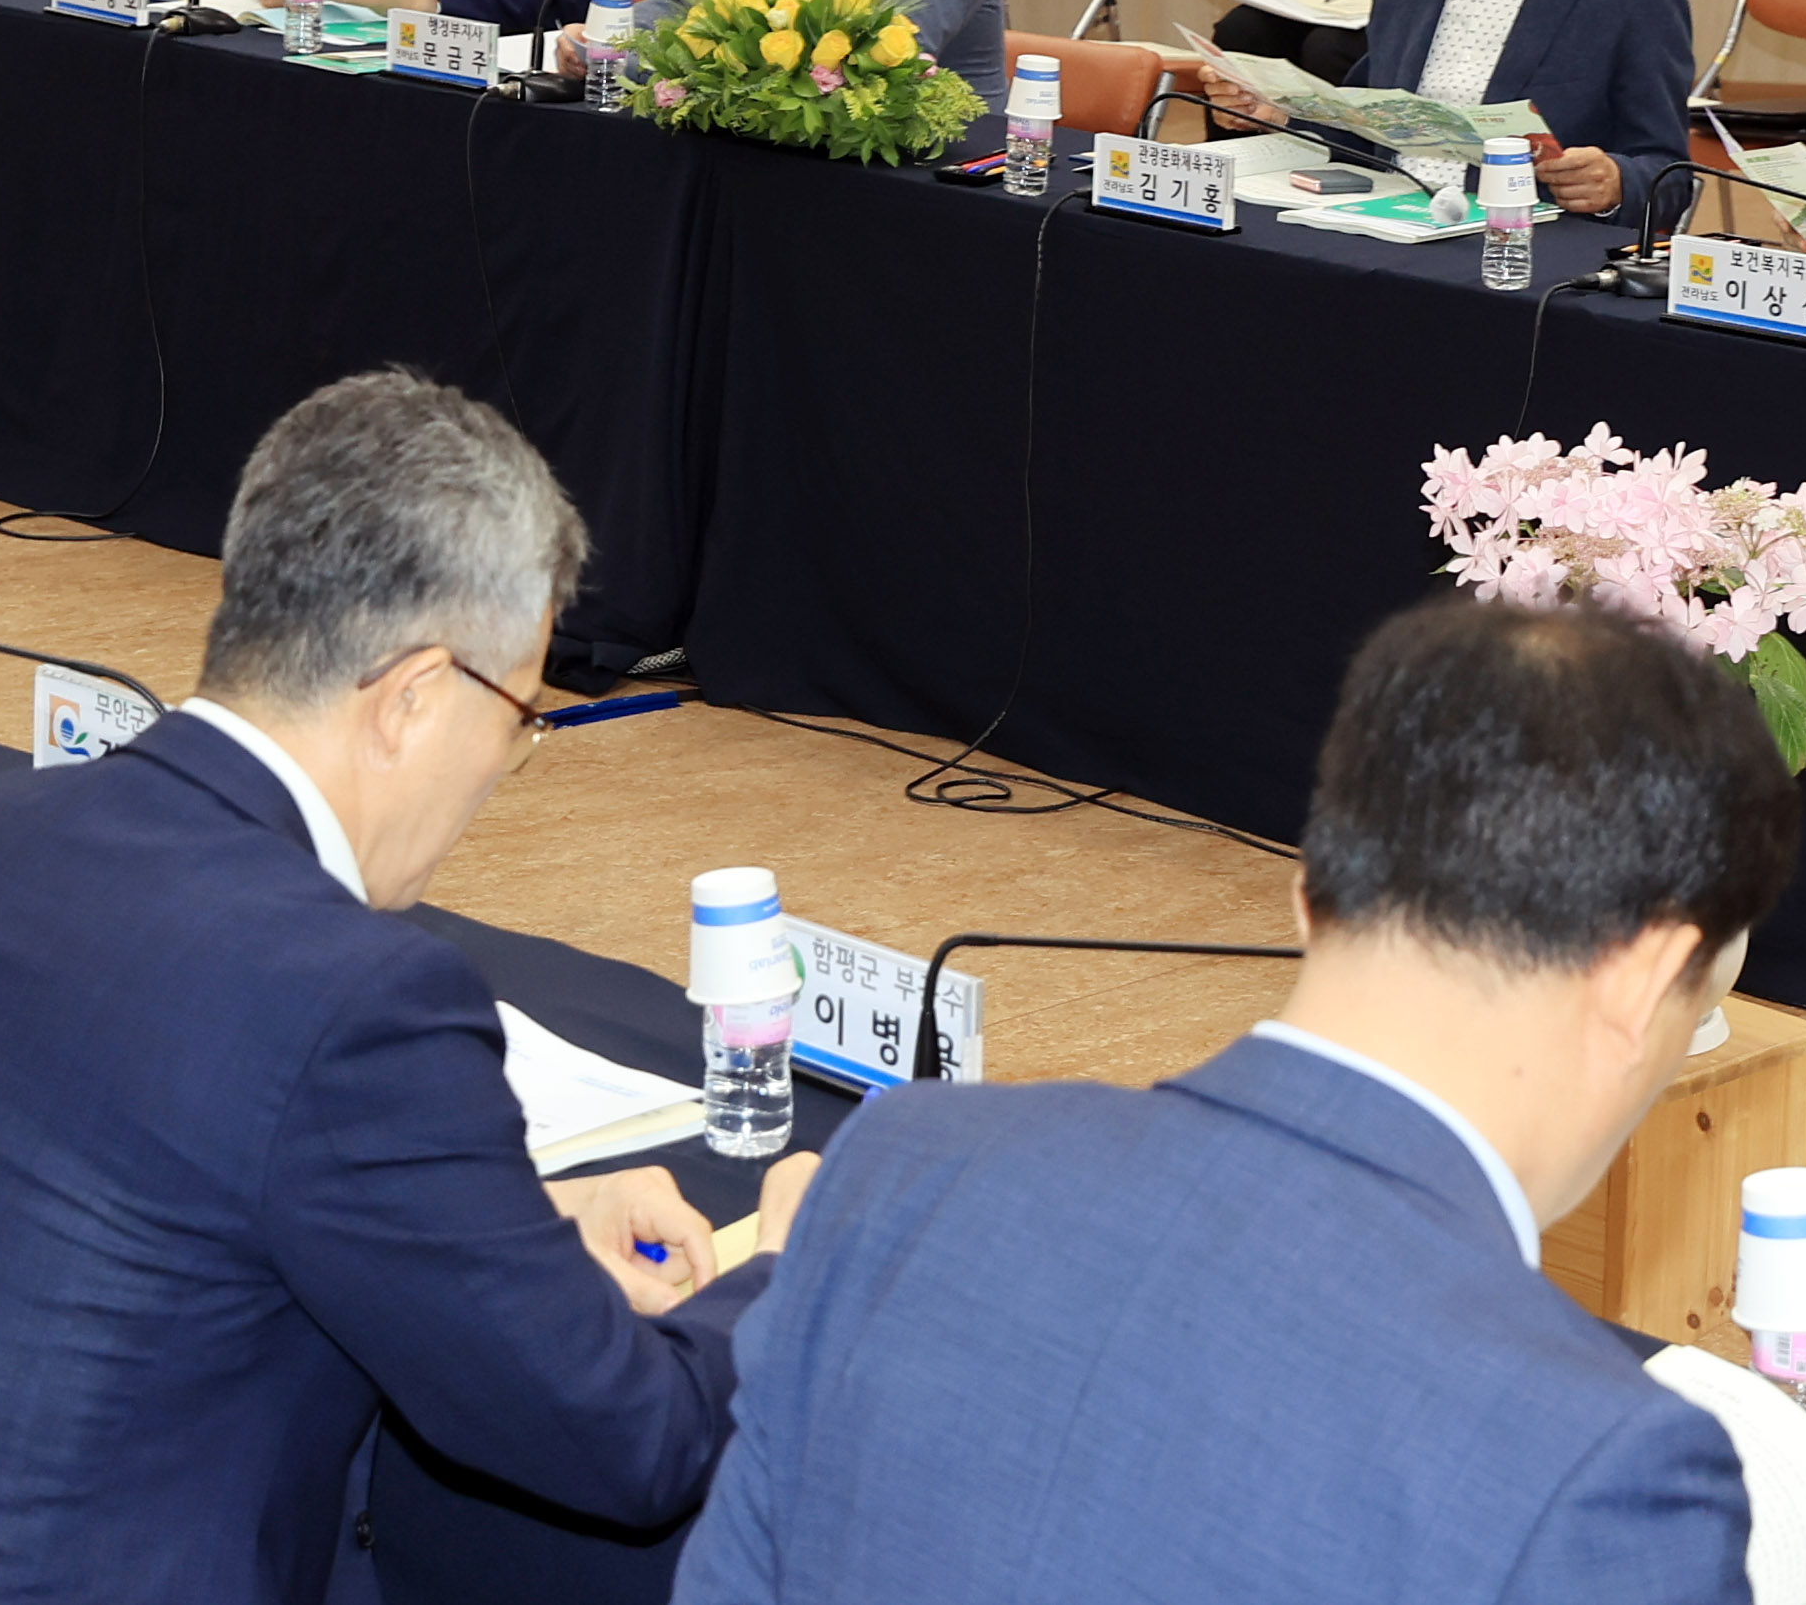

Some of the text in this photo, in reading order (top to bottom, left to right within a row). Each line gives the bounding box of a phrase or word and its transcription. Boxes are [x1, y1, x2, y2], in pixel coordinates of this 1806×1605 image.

[428, 16, 483, 42] 행정부지사
[422, 42, 487, 75] 문금주
[1139, 145, 1225, 178] 관광문화체육국장
[1103, 179, 1135, 194] 전라남도
[1139, 173, 1222, 214] 김기홍
[1681, 285, 1719, 302] 전라남도
[95, 692, 146, 735] 무안군
[813, 937, 964, 1018] 함평군 부수
